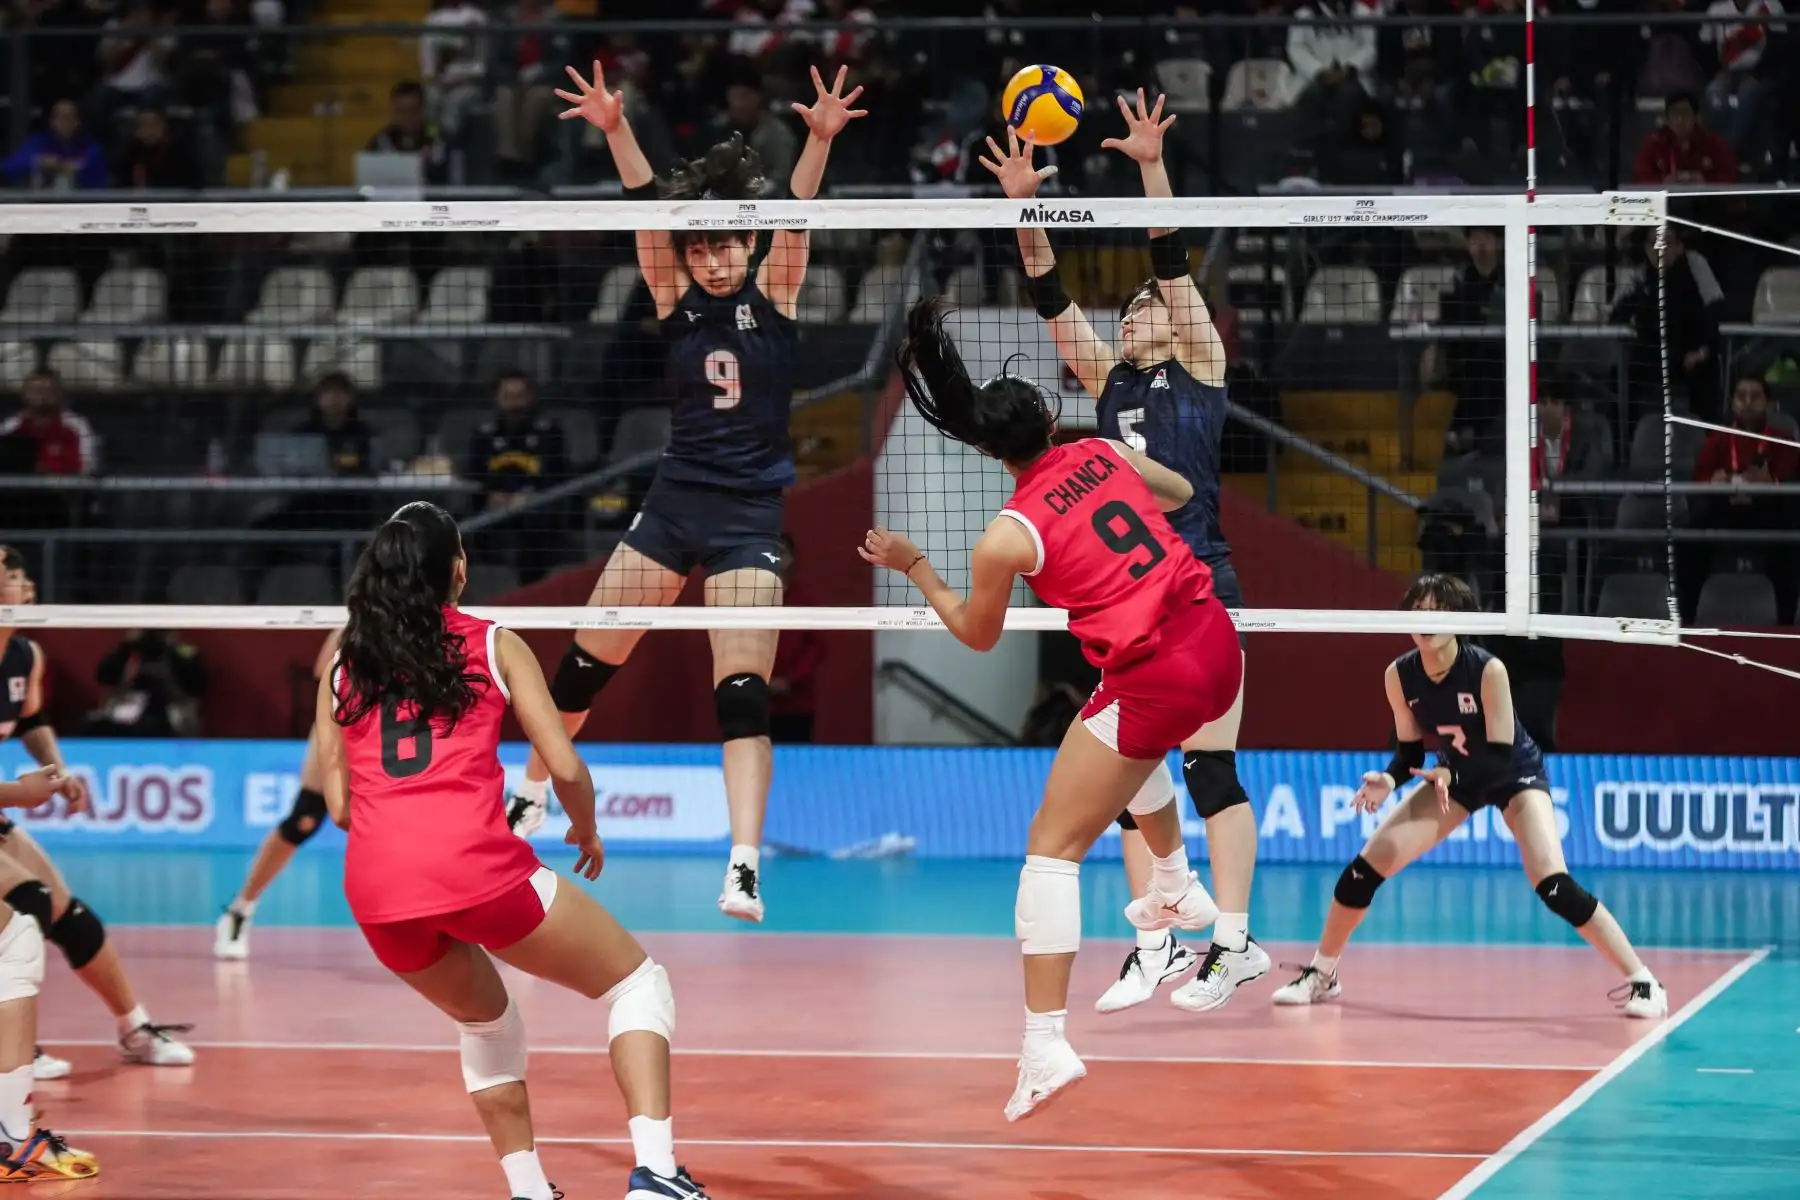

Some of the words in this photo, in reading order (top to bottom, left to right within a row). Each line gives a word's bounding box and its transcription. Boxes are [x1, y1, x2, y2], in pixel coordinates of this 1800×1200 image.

[1372, 214, 1429, 222] CHAMPIONSHIP
[705, 350, 741, 409] 9
[1117, 408, 1146, 456] 5
[1044, 454, 1118, 515] CHANCA
[1091, 500, 1167, 580] 9
[1436, 725, 1469, 757] 7
[1262, 785, 1305, 838] A
[1602, 793, 1800, 841] UUULT
